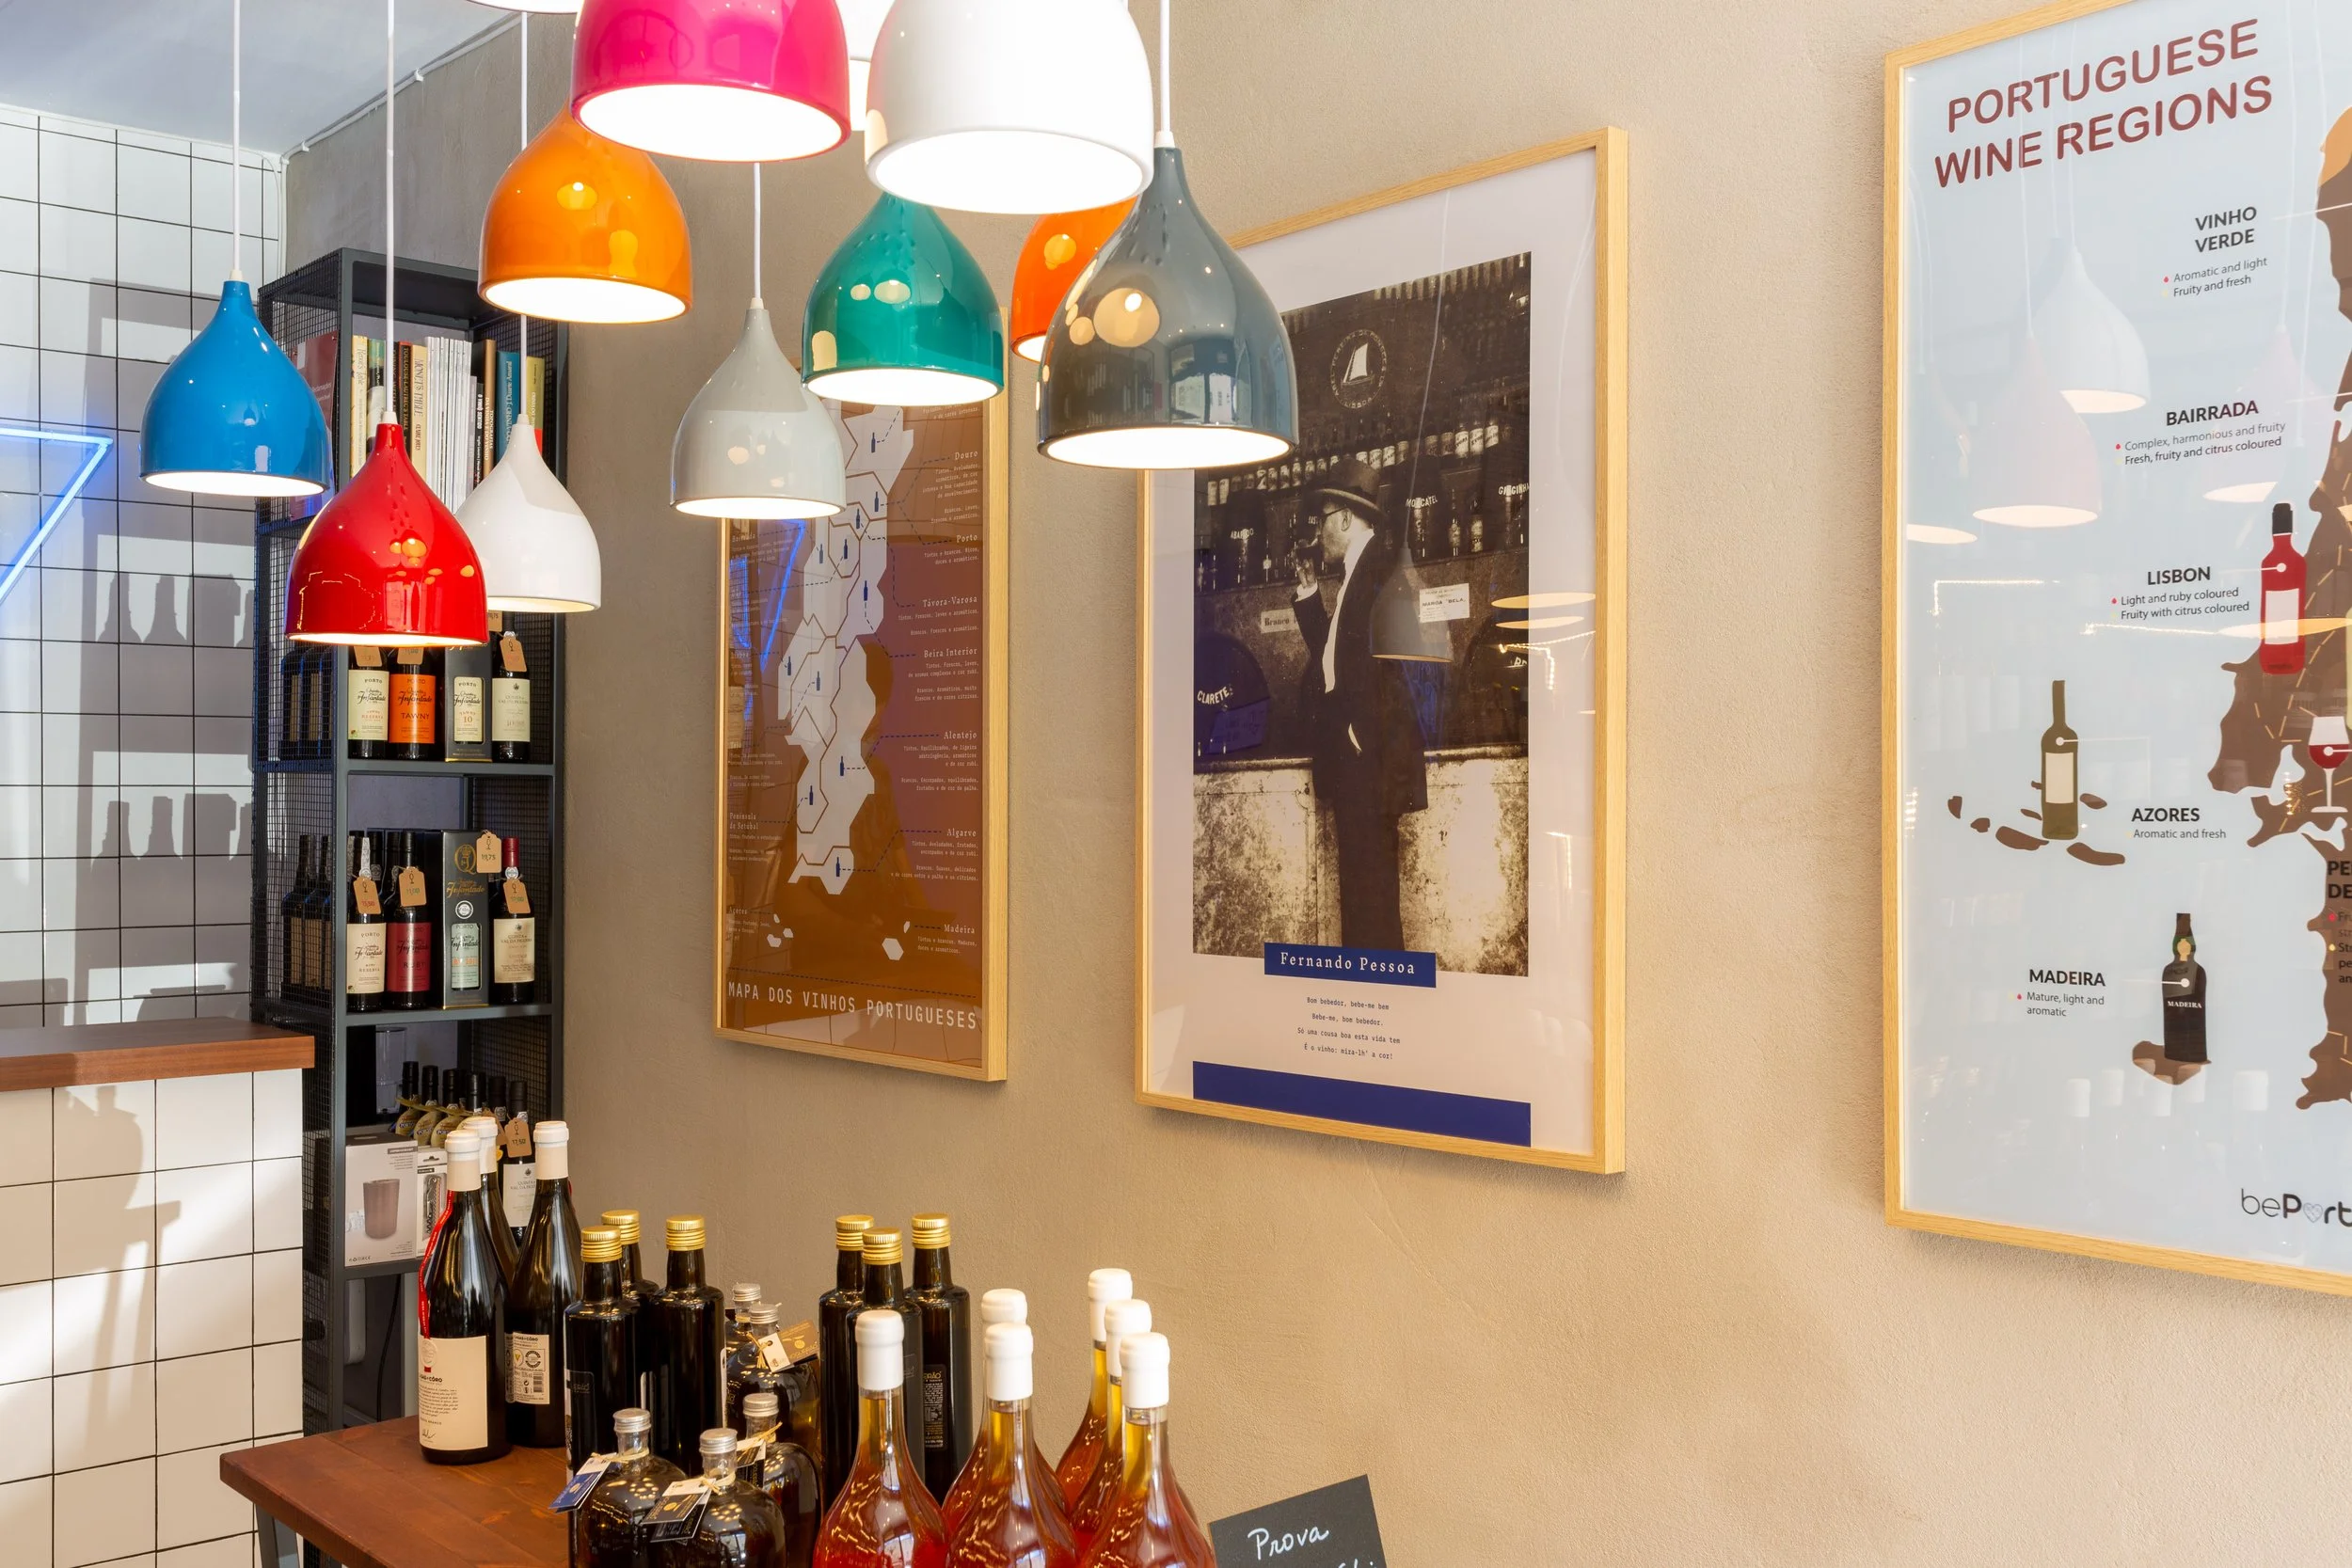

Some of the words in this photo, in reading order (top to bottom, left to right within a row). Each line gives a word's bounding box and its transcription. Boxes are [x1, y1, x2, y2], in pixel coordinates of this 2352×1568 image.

[1948, 18, 2259, 134] PORTUGUESE
[1934, 131, 2042, 187] WINE
[2057, 75, 2272, 160] REGIONS
[2195, 207, 2257, 230] VINHO
[2195, 229, 2254, 253] VERDE
[2174, 267, 2219, 282] Aromatic
[2221, 261, 2241, 274] and
[2244, 258, 2267, 270] light
[2173, 285, 2201, 296] Fruity
[2204, 279, 2223, 292] and
[2226, 275, 2251, 287] fresh
[414, 358, 423, 390] MONET'S
[2167, 400, 2259, 426] BAIRRADA
[2125, 438, 2169, 451] Complex,
[2173, 430, 2233, 445] harmonious
[2235, 425, 2254, 436] and
[2258, 422, 2286, 435] fruity
[955, 451, 977, 460] Douro
[2125, 453, 2153, 466] Fresh,
[2155, 451, 2181, 462] fruity
[2184, 447, 2202, 457] and
[2205, 444, 2233, 455] citrus
[2235, 436, 2281, 451] coloured
[1406, 495, 1438, 508] MOCATEL
[956, 534, 977, 543] Porto
[2148, 566, 2211, 585] LISBON
[922, 596, 977, 608] Távora-Varosa
[2122, 595, 2145, 607] Light
[2148, 593, 2167, 603] and
[2169, 591, 2191, 602] ruby
[2194, 587, 2239, 599] coloured
[2122, 610, 2148, 620] Fruity
[2151, 608, 2172, 617] with
[2175, 605, 2201, 616] citrus
[2204, 601, 2249, 613] coloured
[924, 649, 943, 657] Beira
[946, 647, 977, 657] Interior
[944, 731, 977, 740] Alentejo
[2131, 808, 2200, 822] AZORES
[946, 828, 976, 838] Algarve
[2134, 830, 2177, 838] Aromatic
[2180, 830, 2199, 838] and
[2201, 830, 2226, 838] fresh
[2328, 861, 2352, 876] PE
[945, 924, 975, 934] Madeira
[1280, 952, 1351, 970] Fernando
[1359, 958, 1414, 974] Pessoa
[2029, 969, 2106, 987] MADEIRA
[728, 982, 759, 1000] MAPA
[769, 987, 792, 1005] DOS
[803, 991, 855, 1013] VINHOS
[866, 1000, 977, 1029] PORTUGUESES
[1320, 998, 1347, 1006] bebedor,
[1351, 1001, 1375, 1009] bebe-me
[2027, 992, 2060, 1004] Mature,
[2064, 993, 2084, 1005] light
[2087, 996, 2104, 1005] and
[1312, 1013, 1339, 1022] Bebe-me,
[1356, 1017, 1384, 1026] bebedor.
[2027, 1007, 2067, 1017] aromatic
[1248, 1526, 1329, 1560] Prova
